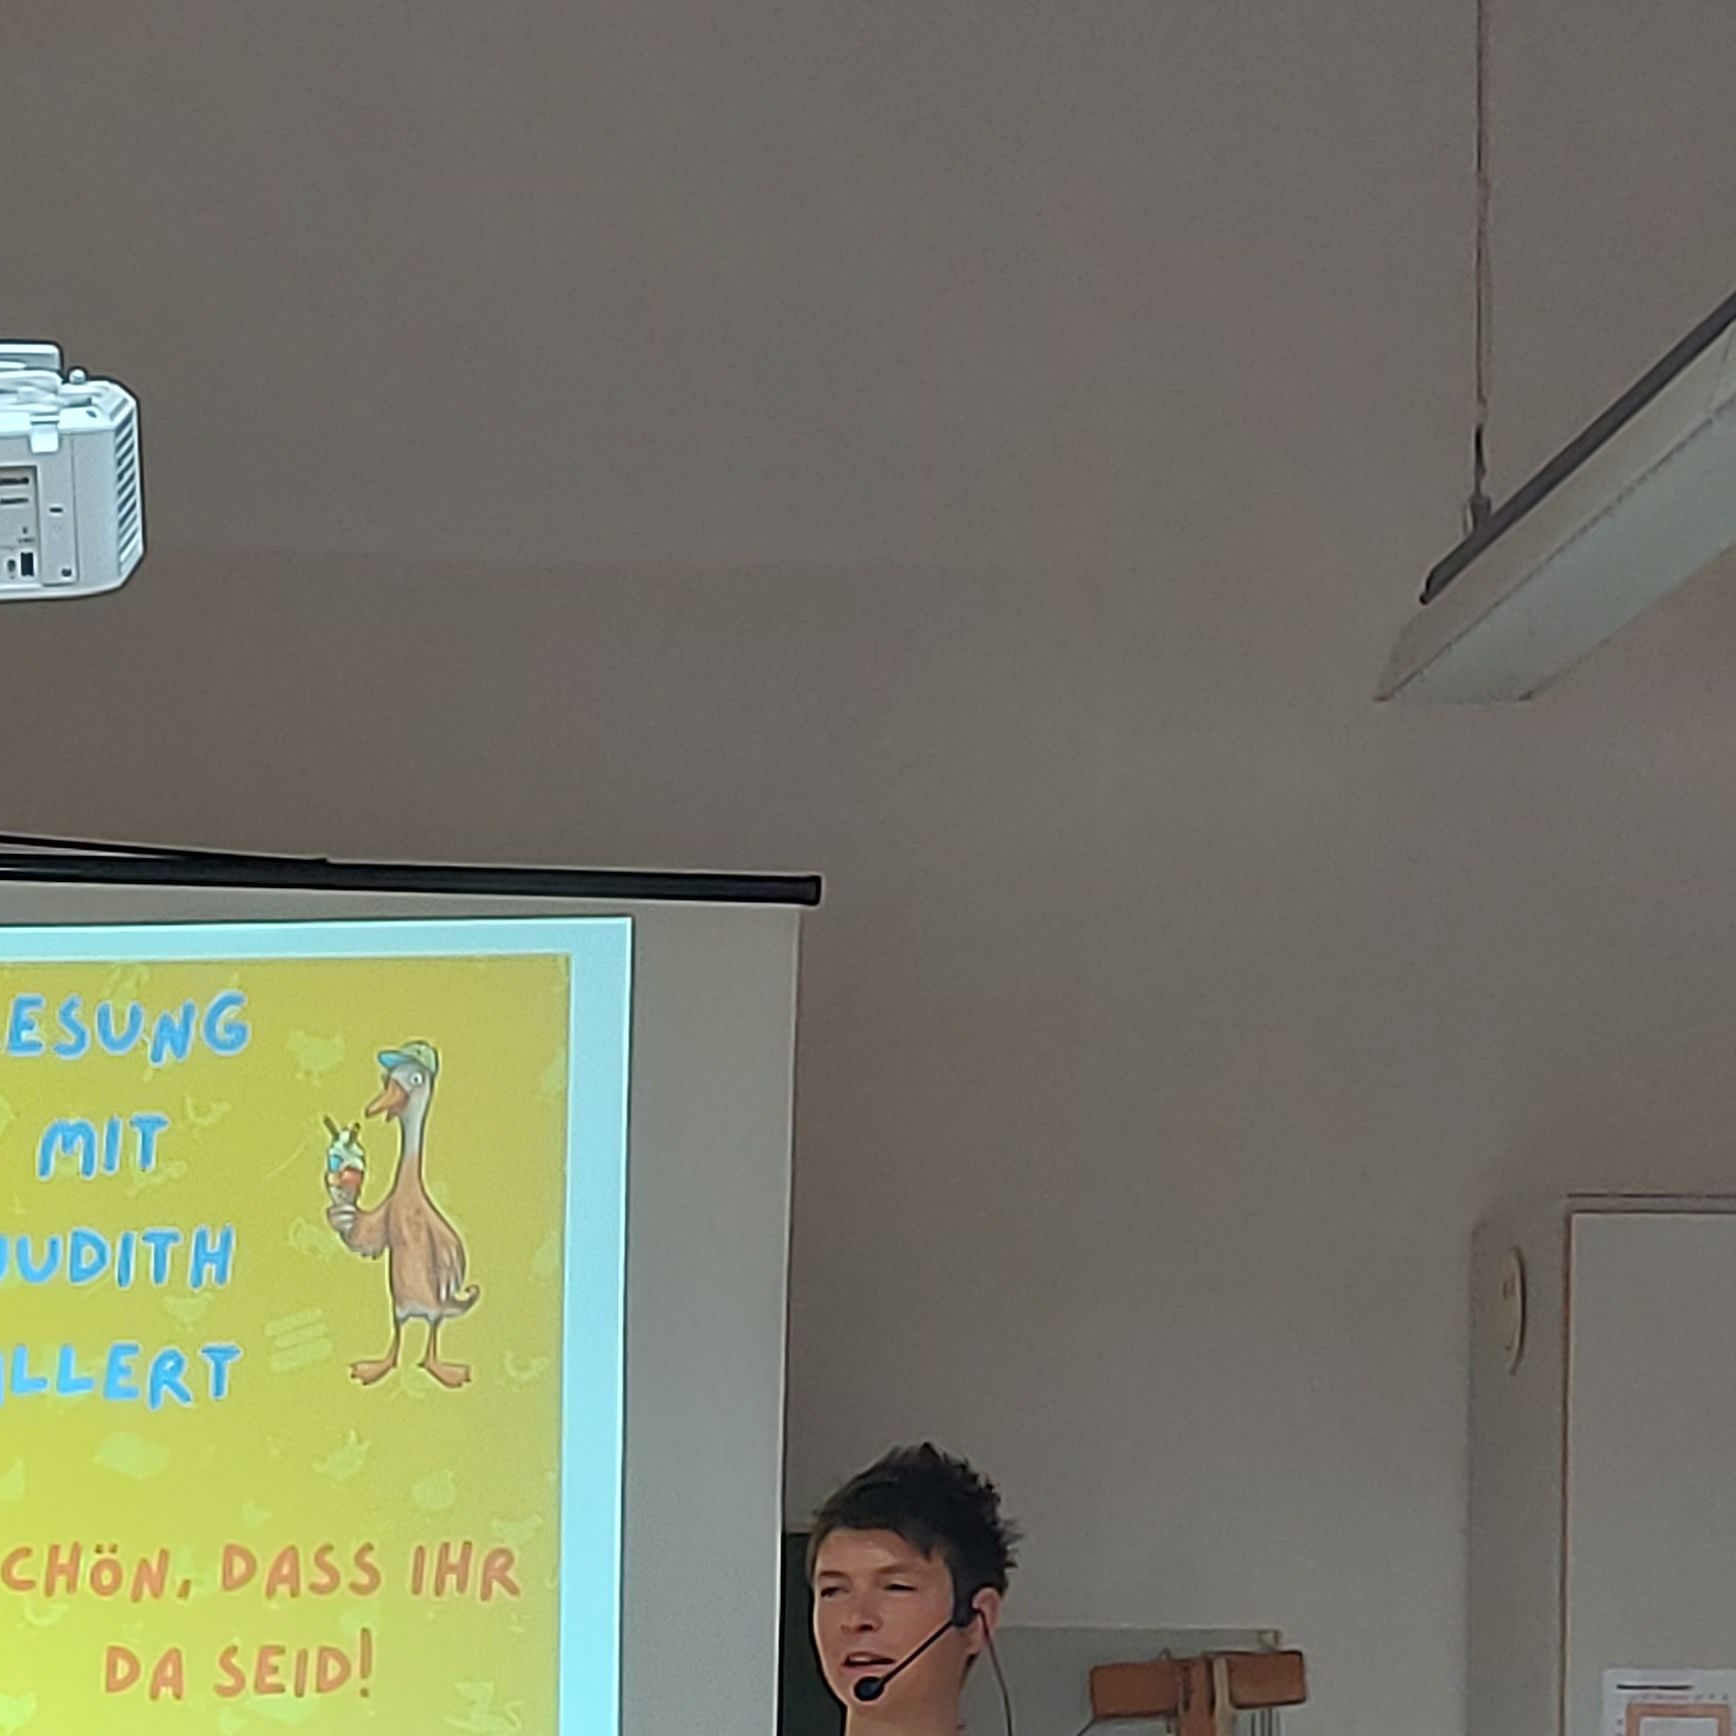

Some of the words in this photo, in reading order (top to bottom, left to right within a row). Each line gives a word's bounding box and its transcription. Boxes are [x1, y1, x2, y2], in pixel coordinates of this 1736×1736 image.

[37, 1112, 170, 1180] MIT
[220, 1542, 383, 1599] DASS
[411, 1540, 522, 1602] IHR
[103, 1644, 186, 1702] DA
[212, 1627, 375, 1702] SEID!
